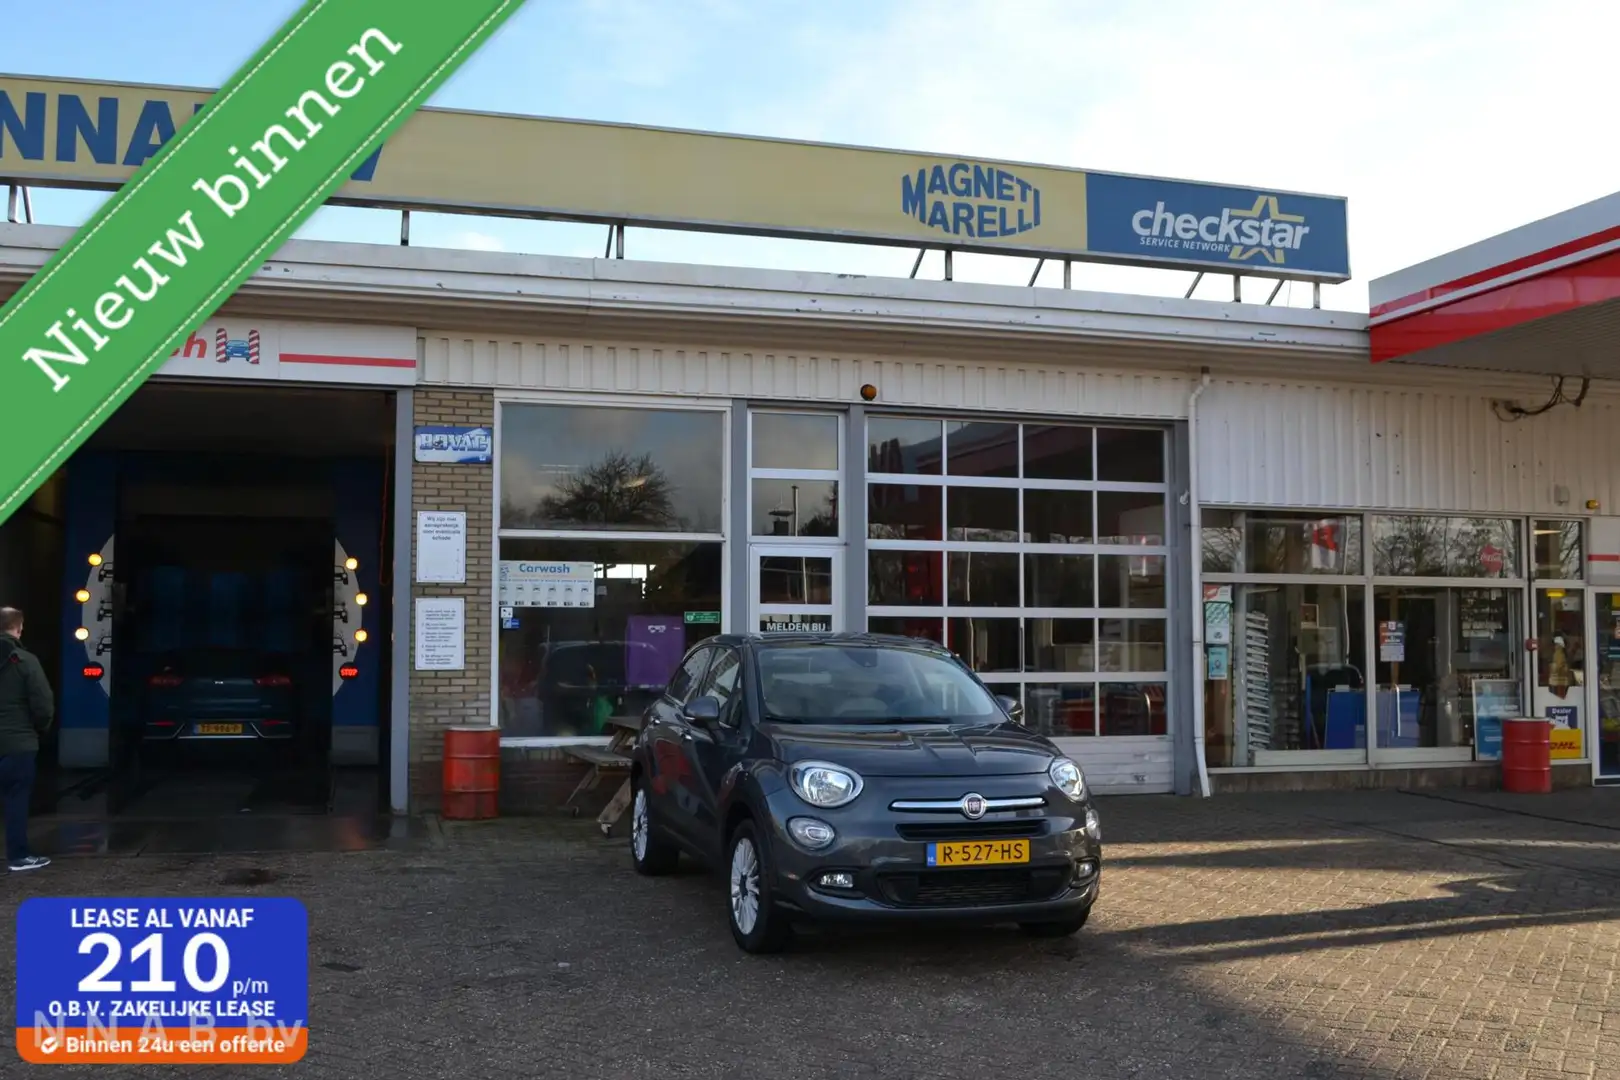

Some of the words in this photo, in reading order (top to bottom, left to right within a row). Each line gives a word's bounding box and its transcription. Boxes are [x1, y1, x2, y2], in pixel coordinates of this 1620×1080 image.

[0, 90, 201, 166] NNA
[902, 163, 1041, 212] MAGNETI
[902, 190, 1041, 238] MARELLI
[1132, 201, 1310, 250] checkstar
[1140, 237, 1179, 248] SERVICE
[1183, 241, 1231, 253] NETWORK
[519, 563, 570, 574] Carwash
[766, 622, 809, 632] MELDEN
[811, 624, 826, 632] BIJ
[340, 668, 358, 676] STOP
[943, 844, 1024, 862] R-527-HS
